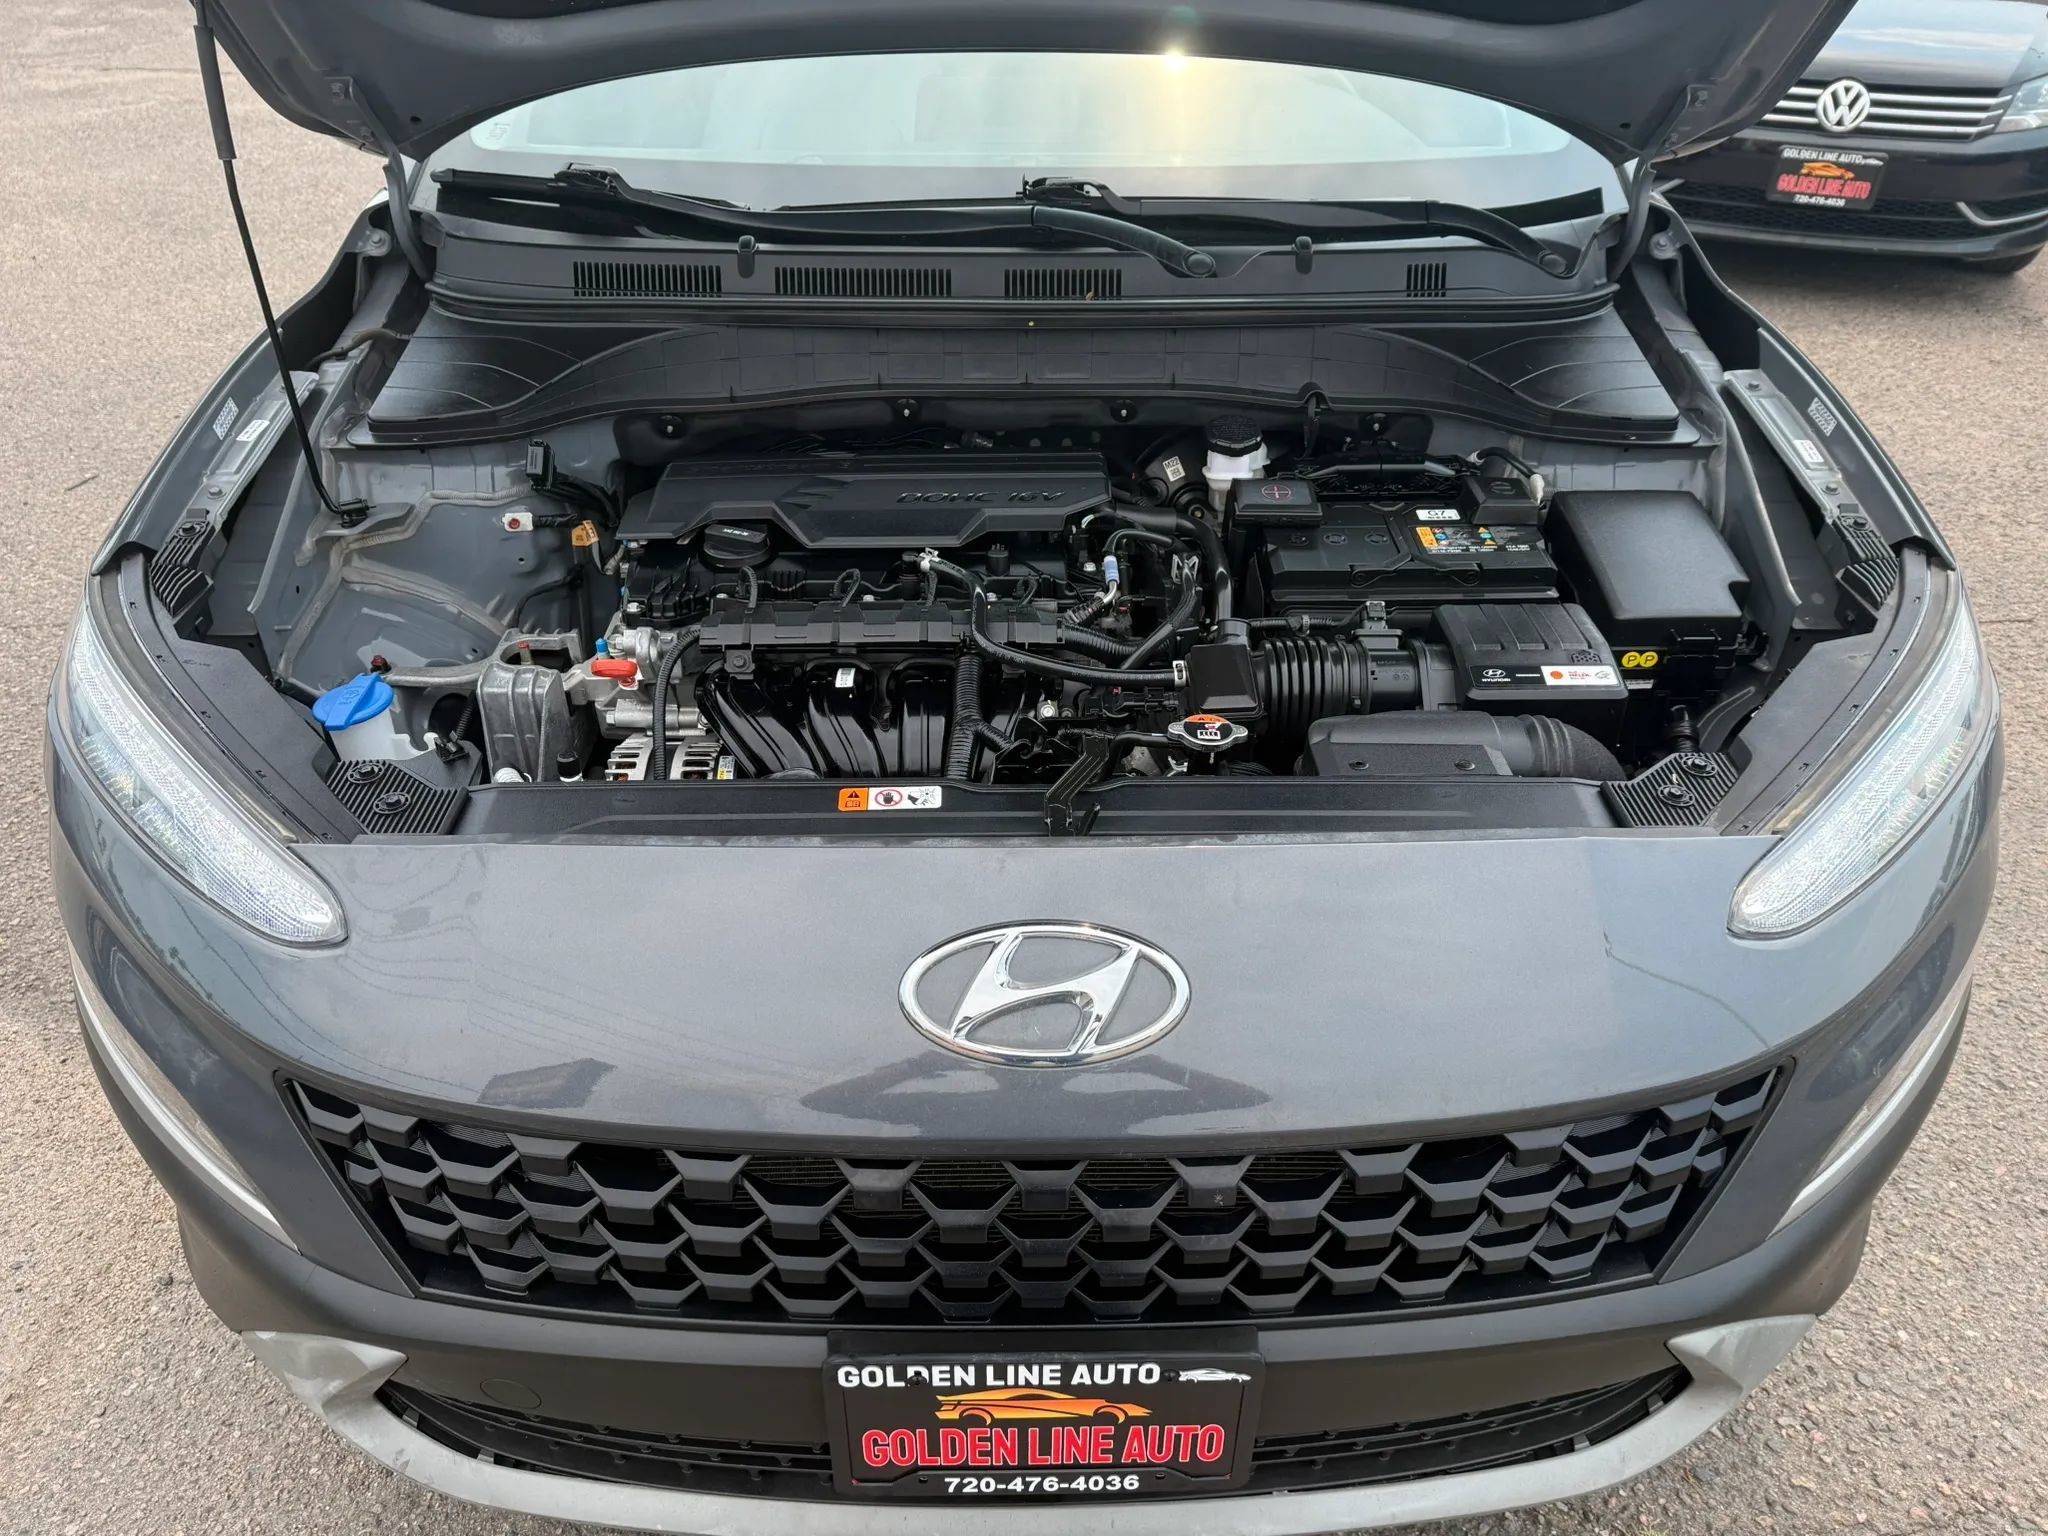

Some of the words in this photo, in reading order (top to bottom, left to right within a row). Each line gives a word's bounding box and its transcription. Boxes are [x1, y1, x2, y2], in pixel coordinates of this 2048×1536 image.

[1783, 148, 1818, 159] GOLDEN
[1819, 152, 1839, 162] LINE
[1838, 154, 1863, 163] AUTO
[1777, 175, 1819, 193] GOLDEN
[1818, 178, 1844, 196] LINE
[1842, 181, 1871, 199] AUTO
[897, 492, 1000, 504] DOHC
[1008, 491, 1065, 502] 16V
[837, 1365, 976, 1387] GOLDEN
[986, 1364, 1061, 1386] LINE
[1070, 1362, 1161, 1385] AUTO
[862, 1427, 1018, 1466] GOLDEN
[1028, 1426, 1114, 1464] LINE
[1122, 1424, 1225, 1463] AUTO
[944, 1475, 1140, 1493] 720-476-4036
